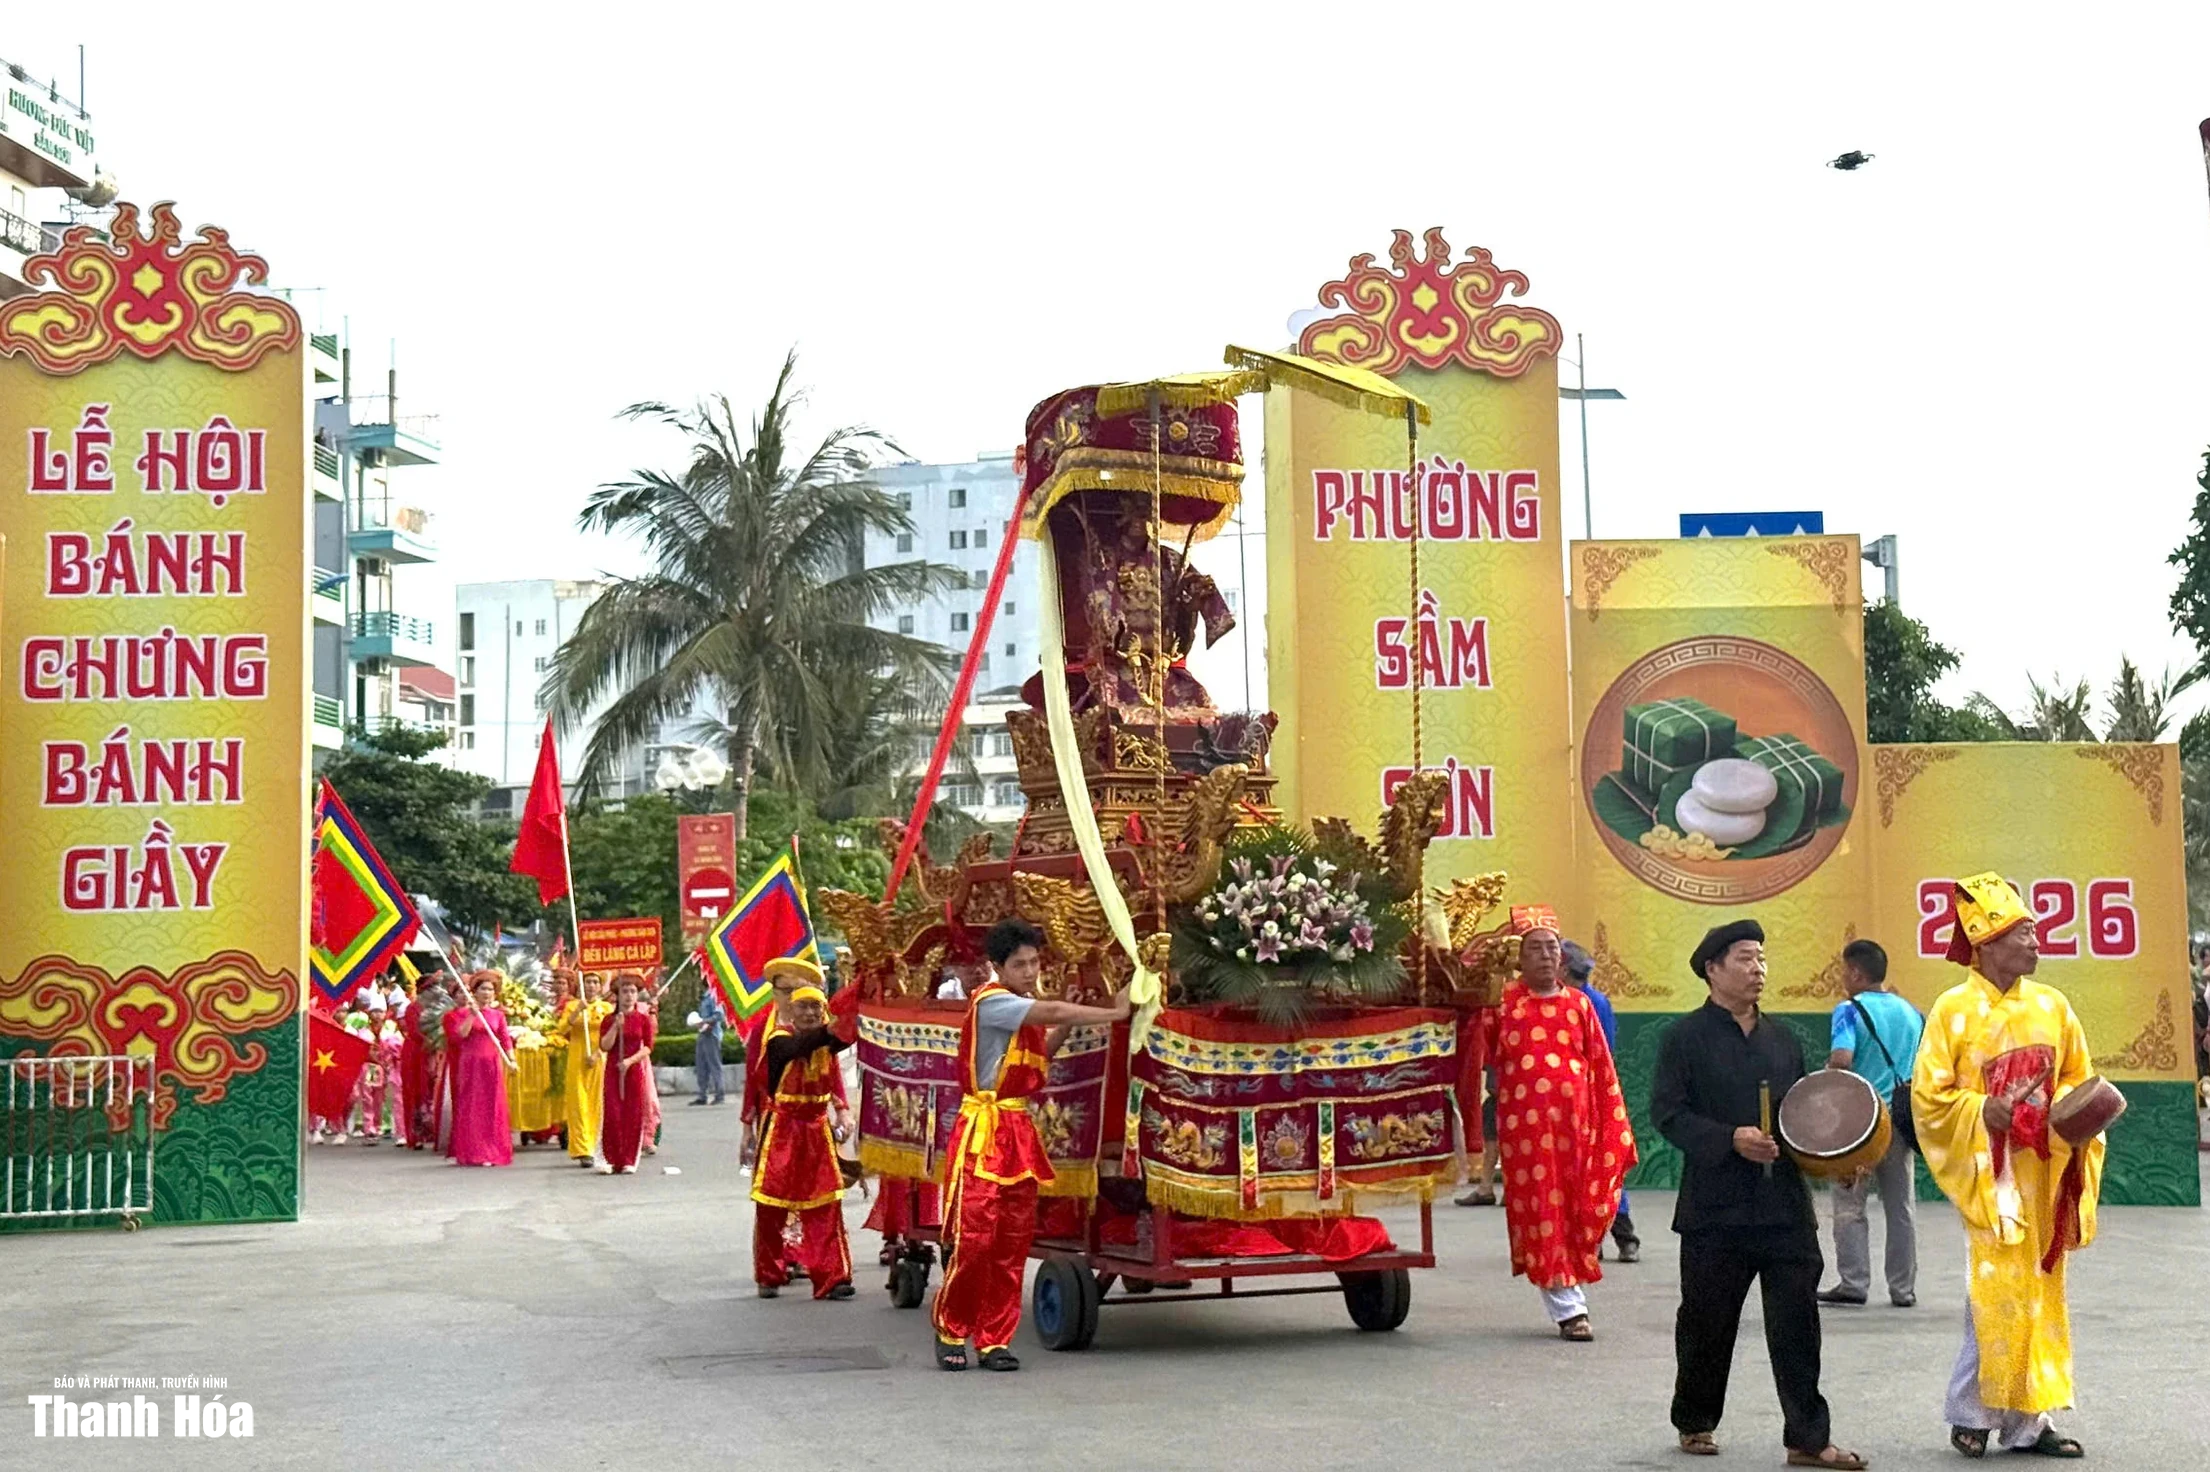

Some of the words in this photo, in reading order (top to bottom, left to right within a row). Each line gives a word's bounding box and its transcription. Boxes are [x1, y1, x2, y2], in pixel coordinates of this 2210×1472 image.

[30, 405, 113, 491] LỄ
[137, 416, 264, 506] HỘI
[1315, 456, 1539, 540] PHƯỜNG
[48, 519, 243, 595] BÁNH
[24, 627, 267, 700] CHƯNG
[1376, 590, 1490, 688] SẦM
[44, 727, 242, 805] BÁNH
[62, 819, 226, 911] GIẦY
[1919, 880, 2137, 957] 226
